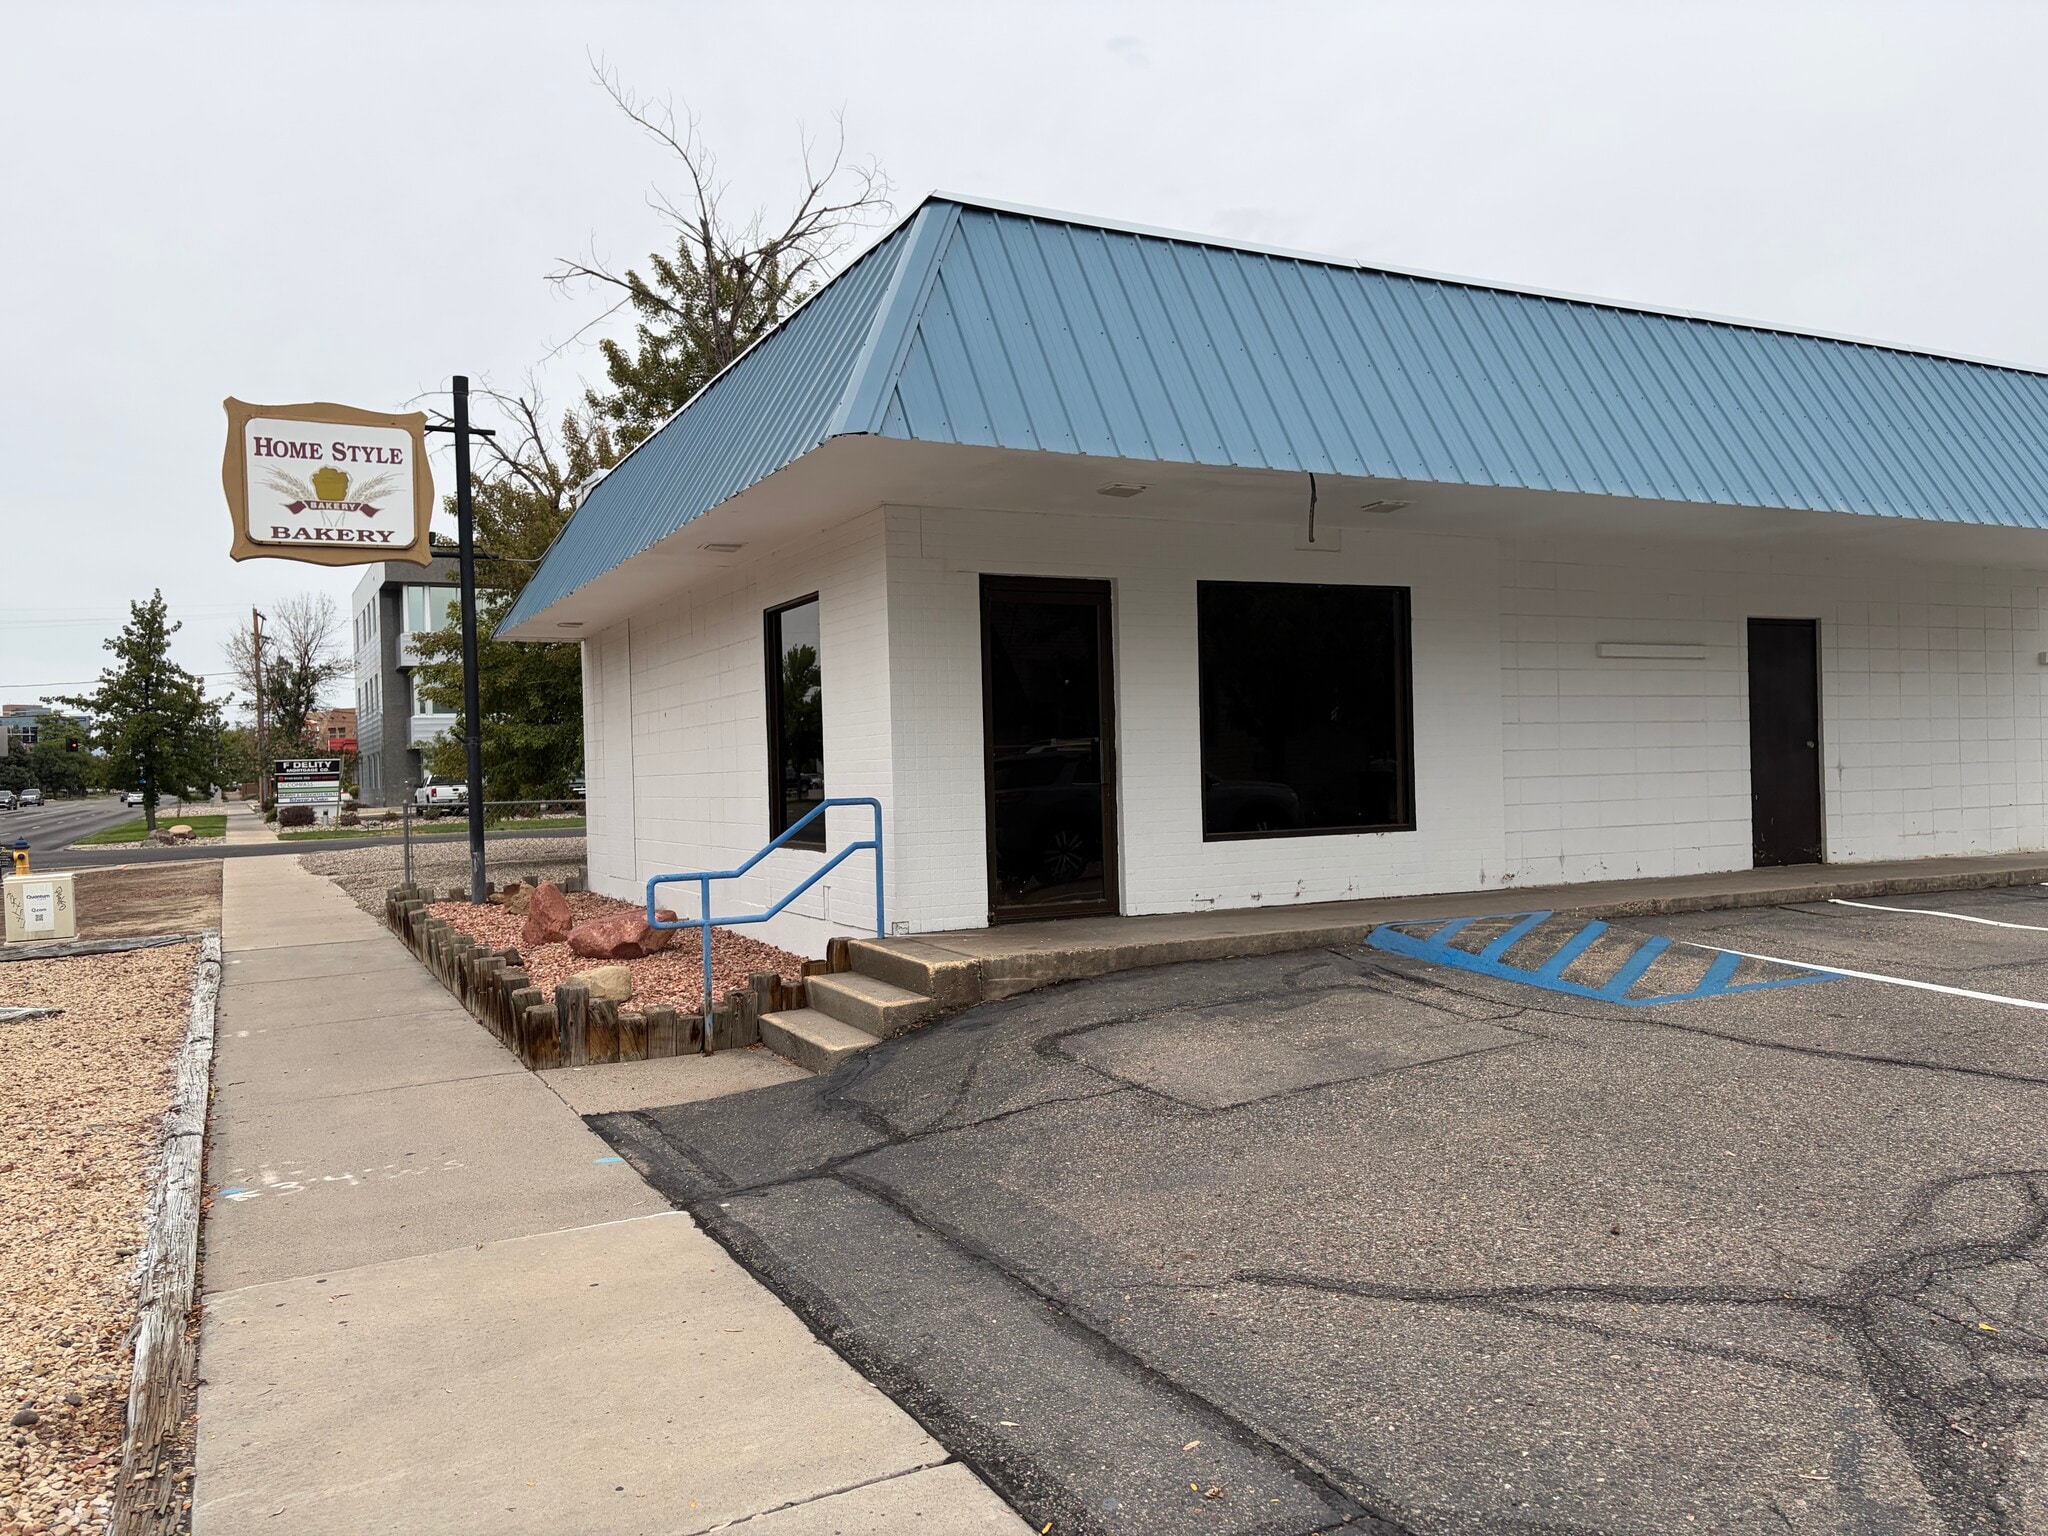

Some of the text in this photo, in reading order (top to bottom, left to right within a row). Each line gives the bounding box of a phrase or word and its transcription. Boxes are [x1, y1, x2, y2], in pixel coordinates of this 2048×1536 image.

[253, 436, 404, 465] HOME STYLE
[310, 501, 356, 511] BAKERY
[270, 526, 395, 543] BAKERY
